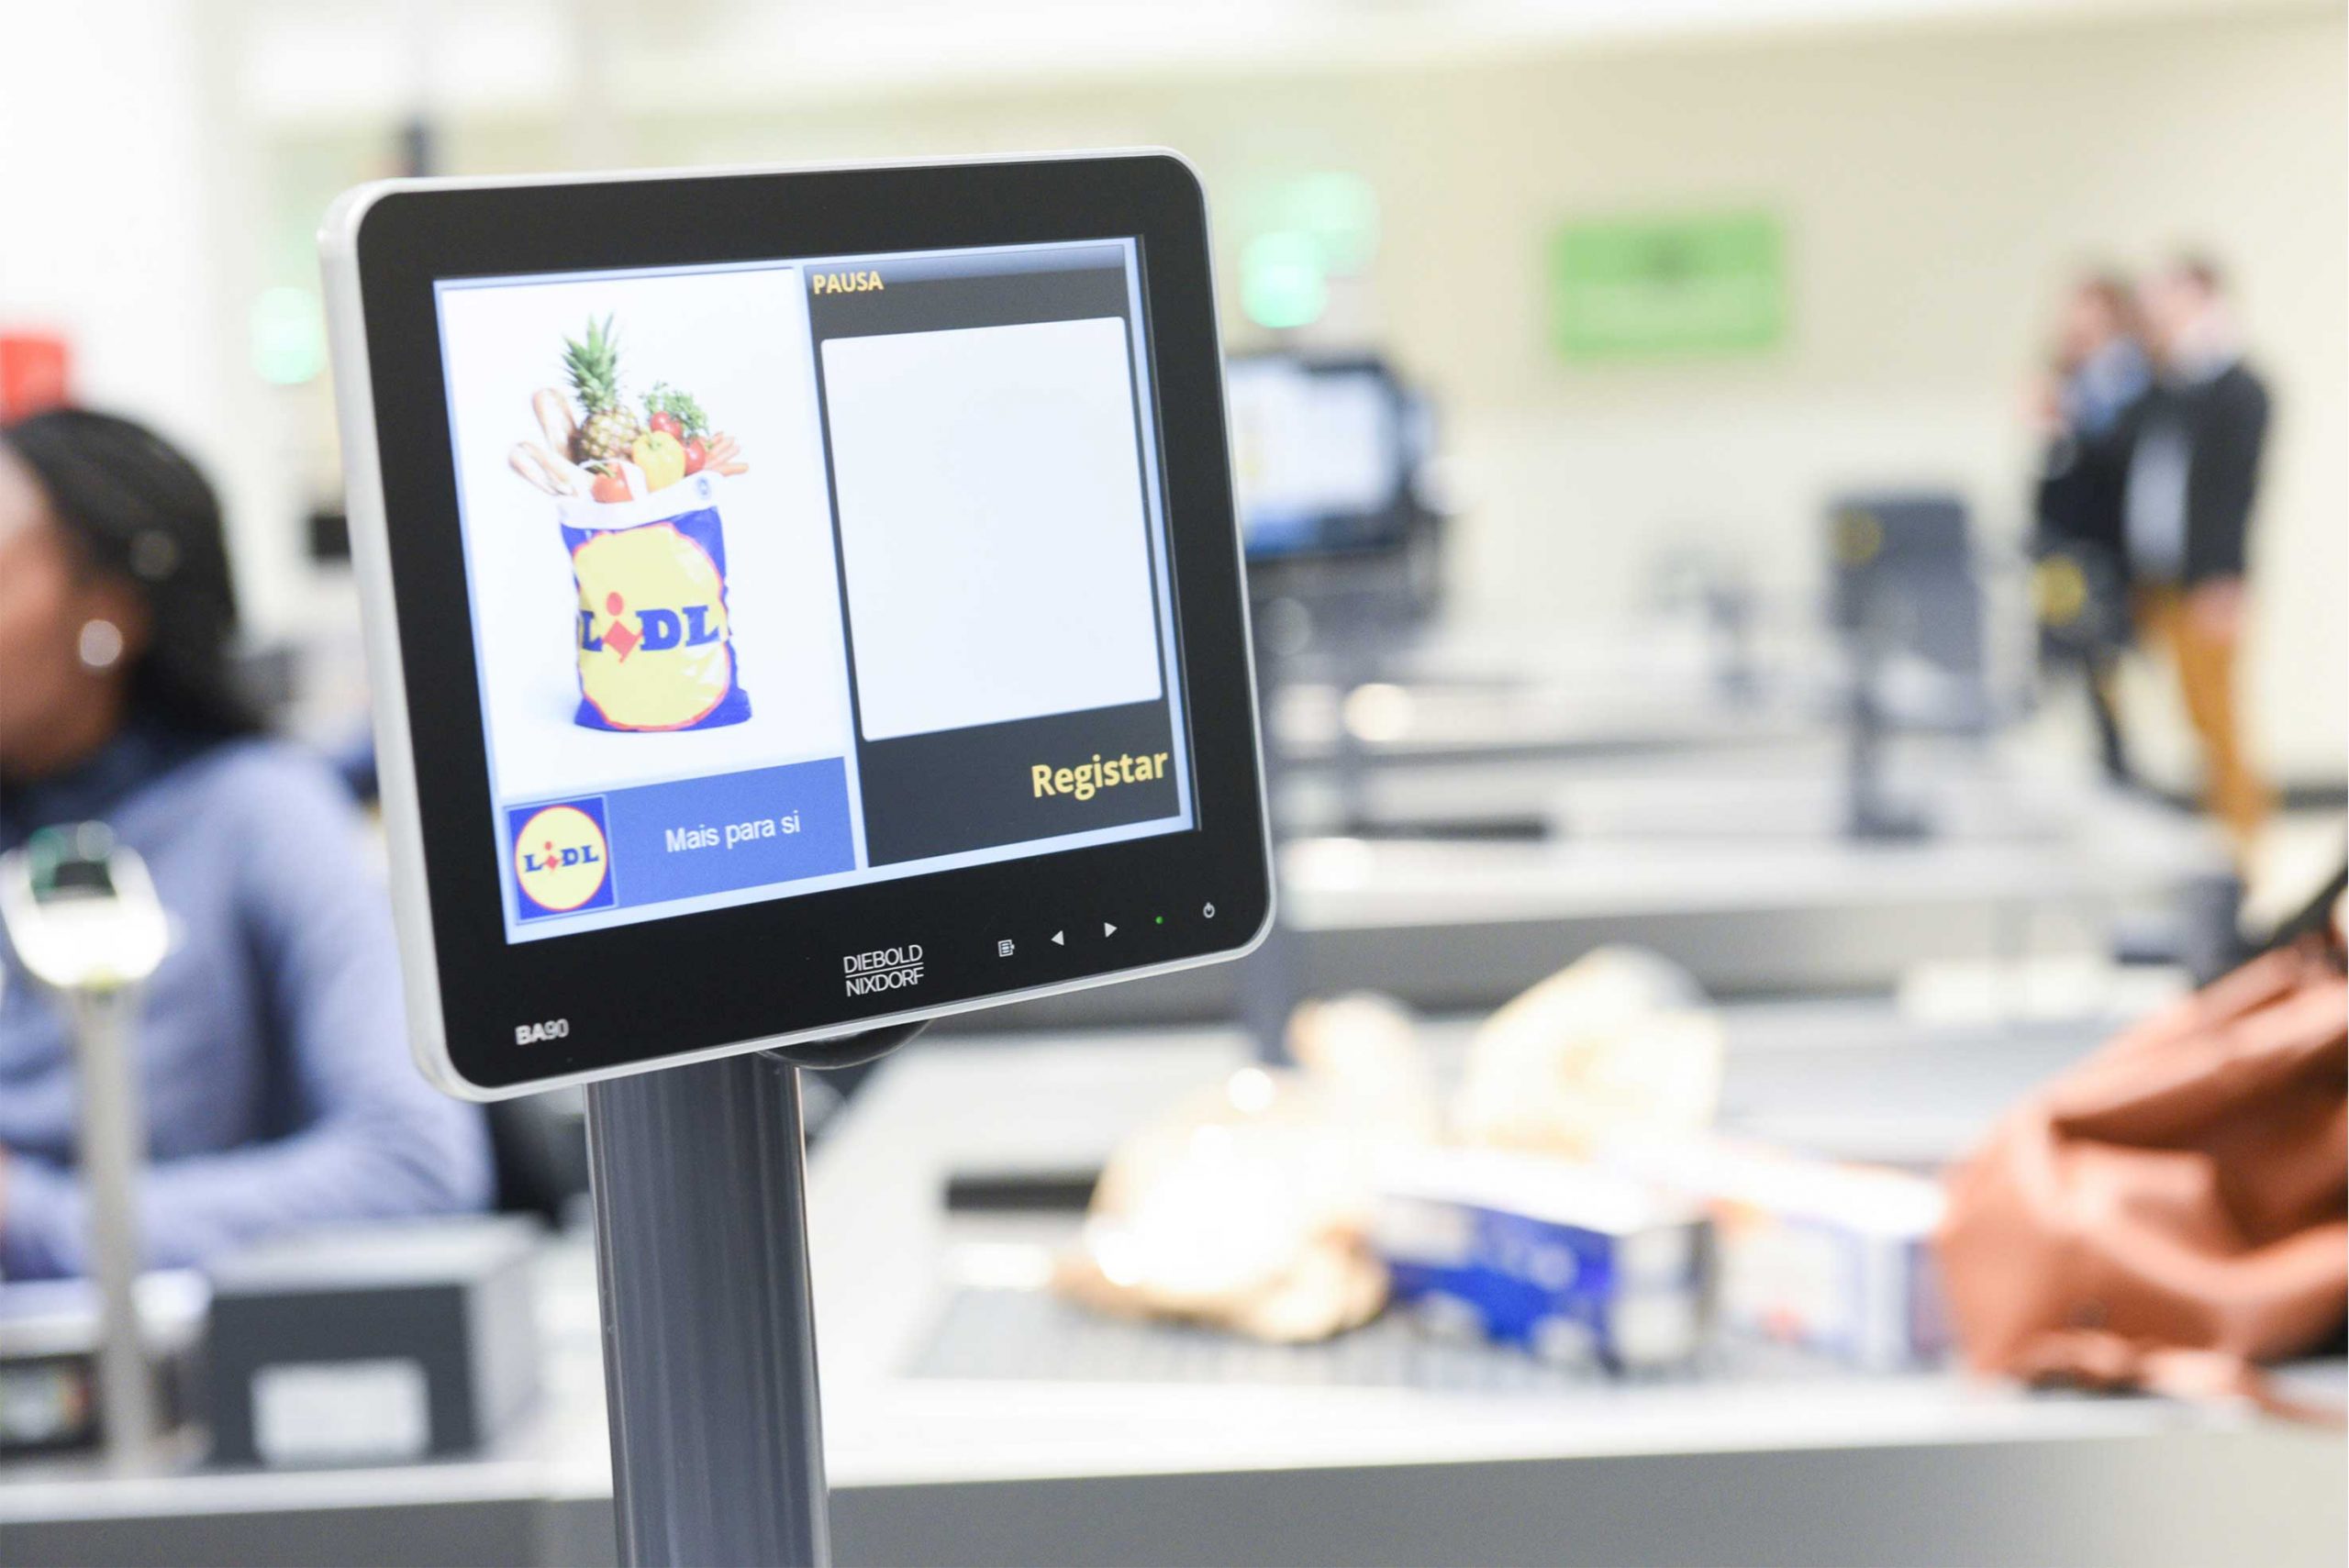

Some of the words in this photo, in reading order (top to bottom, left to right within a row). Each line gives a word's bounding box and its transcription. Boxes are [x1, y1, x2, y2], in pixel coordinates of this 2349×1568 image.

[813, 271, 885, 295] PAUSA
[1031, 751, 1169, 802] Registar
[665, 824, 720, 853] Mais
[726, 820, 776, 850] para
[780, 809, 801, 835] si
[843, 944, 923, 973] DIEBOLD
[846, 967, 924, 996] NIXDORF
[516, 1018, 570, 1046] BA90
